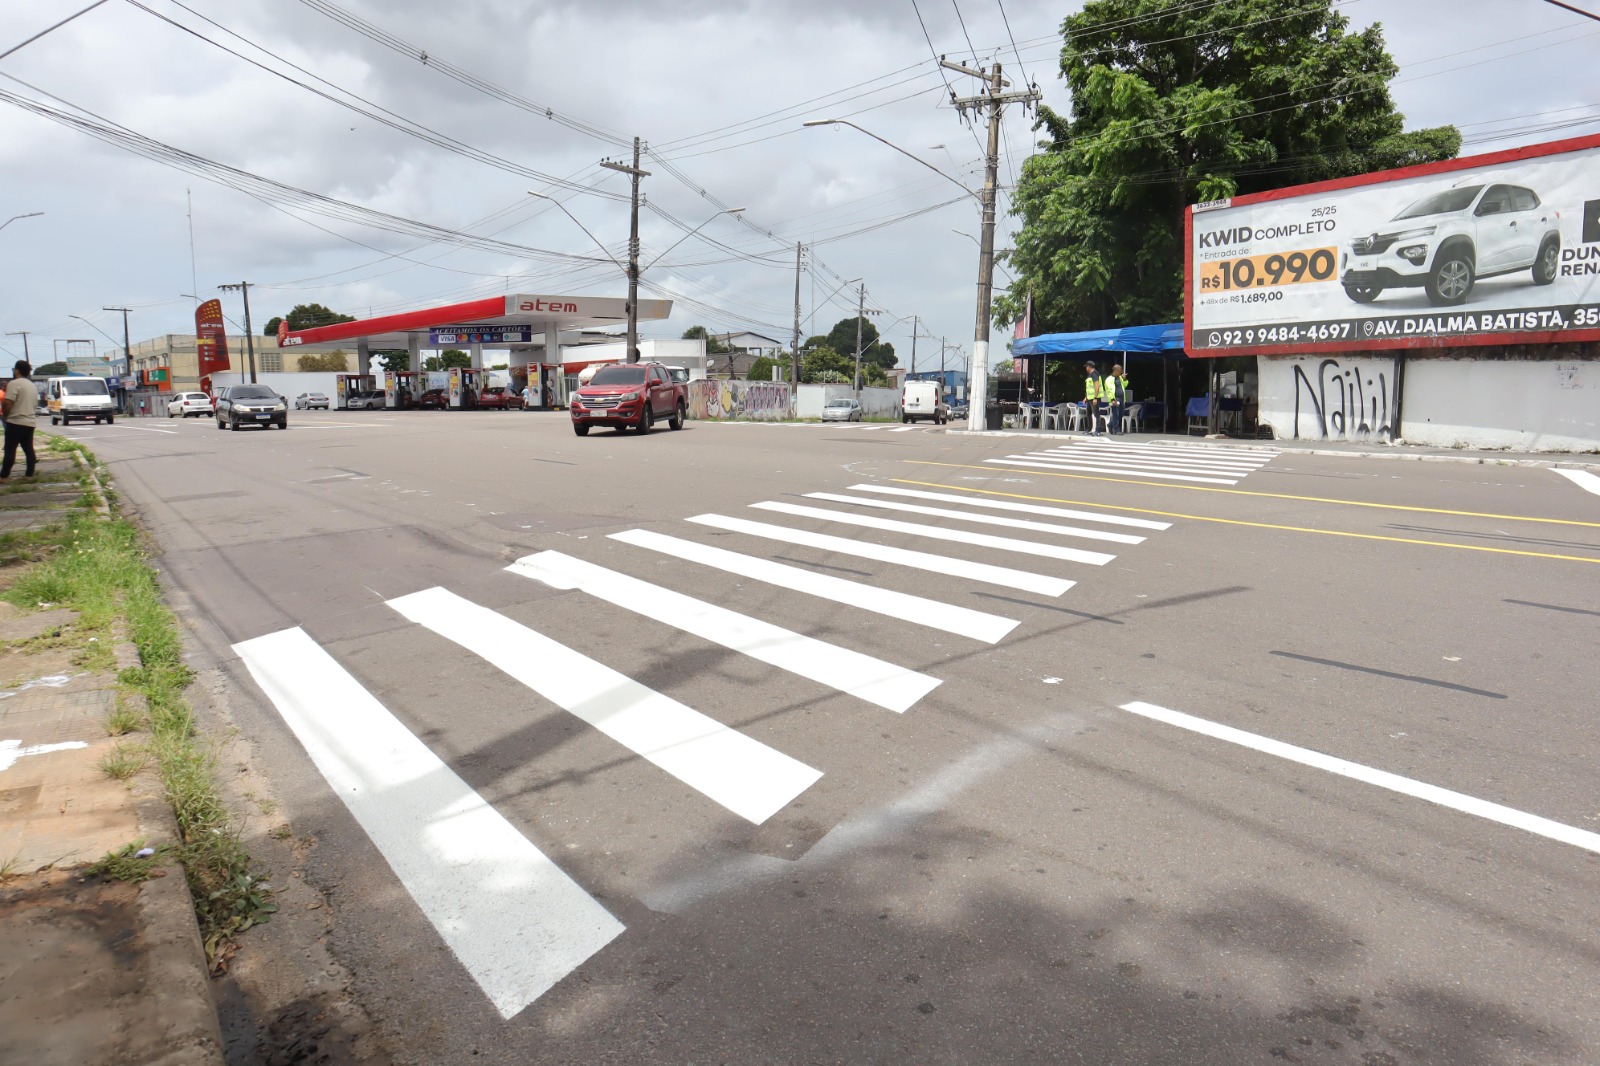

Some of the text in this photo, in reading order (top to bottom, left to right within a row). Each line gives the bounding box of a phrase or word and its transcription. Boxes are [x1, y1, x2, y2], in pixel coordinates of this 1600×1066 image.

[1311, 205, 1337, 217] 25/25
[1199, 219, 1336, 249] KWID COMPLETO
[1204, 248, 1237, 260] Entrada
[1560, 261, 1600, 277] REN
[1240, 291, 1283, 304] 1.689,00
[519, 298, 578, 313] atem
[1374, 308, 1600, 336] AV. DJALMA BATISTA, 35
[1223, 322, 1351, 345] 92 9 9484-4697
